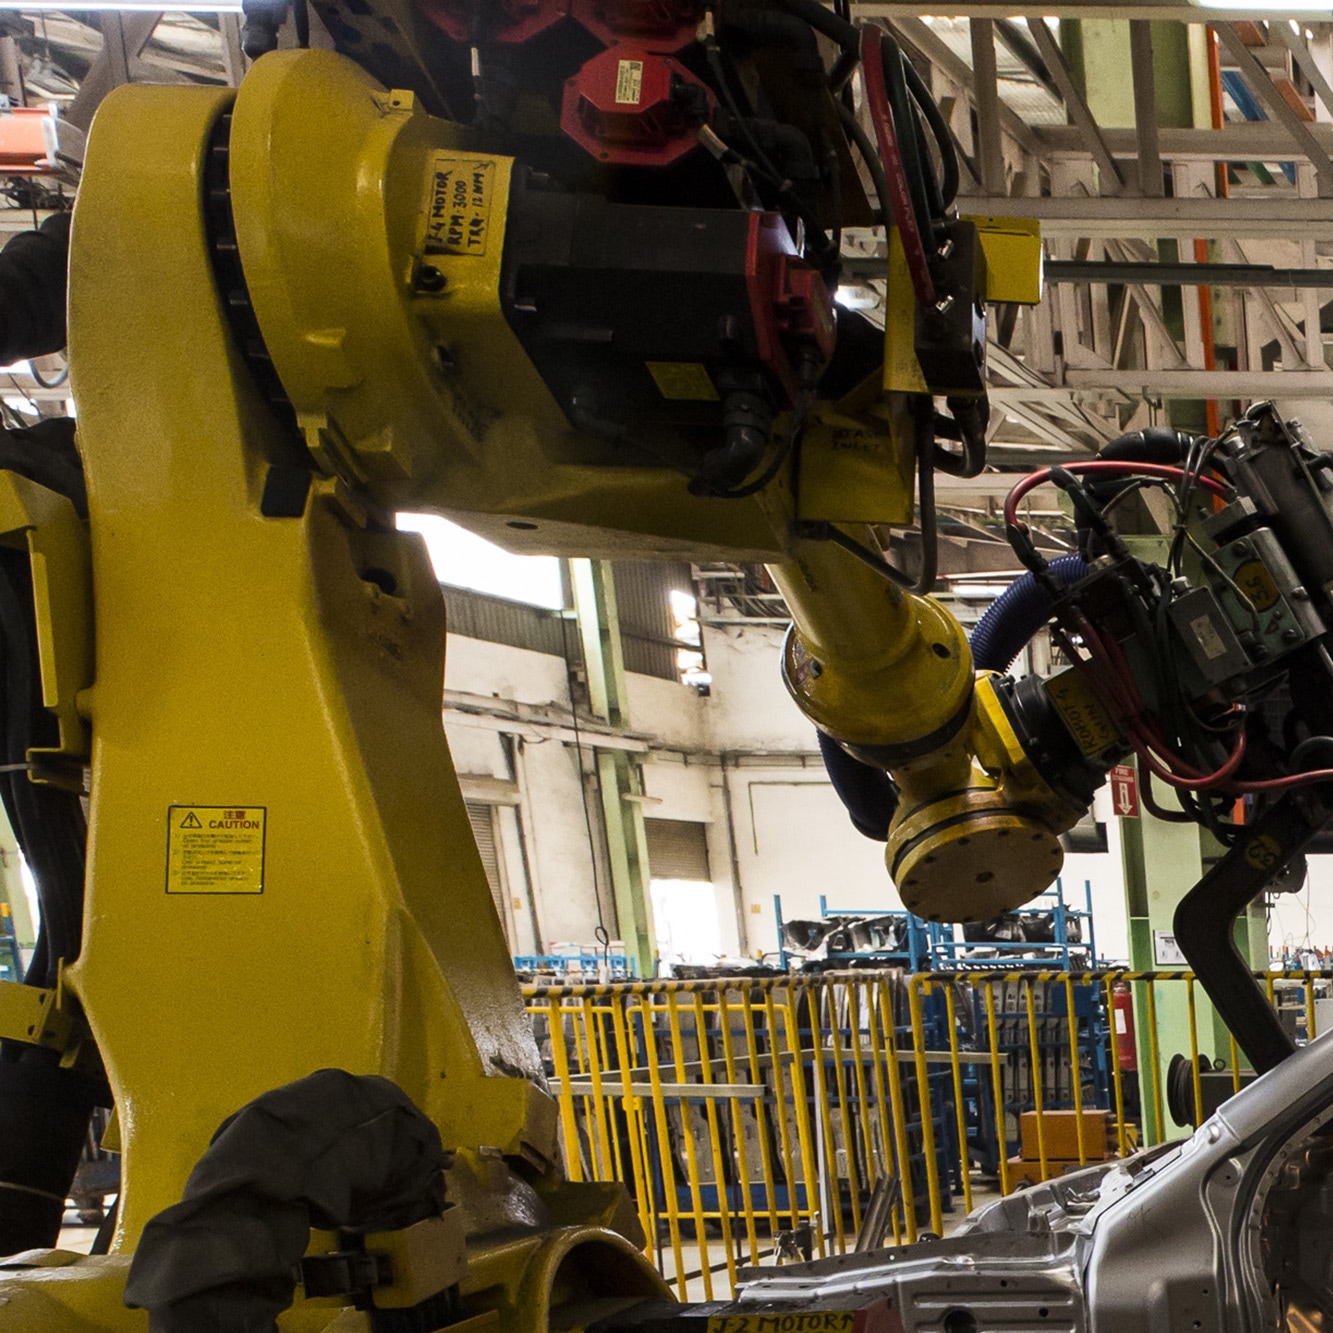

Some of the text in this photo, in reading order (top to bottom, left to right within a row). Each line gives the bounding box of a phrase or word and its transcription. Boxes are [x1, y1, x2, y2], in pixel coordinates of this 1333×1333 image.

[432, 170, 453, 218] MOTOR
[1063, 705, 1097, 750] ROBOT
[208, 819, 261, 830] CAUTION
[713, 1313, 840, 1333] J-2 MOTOR
